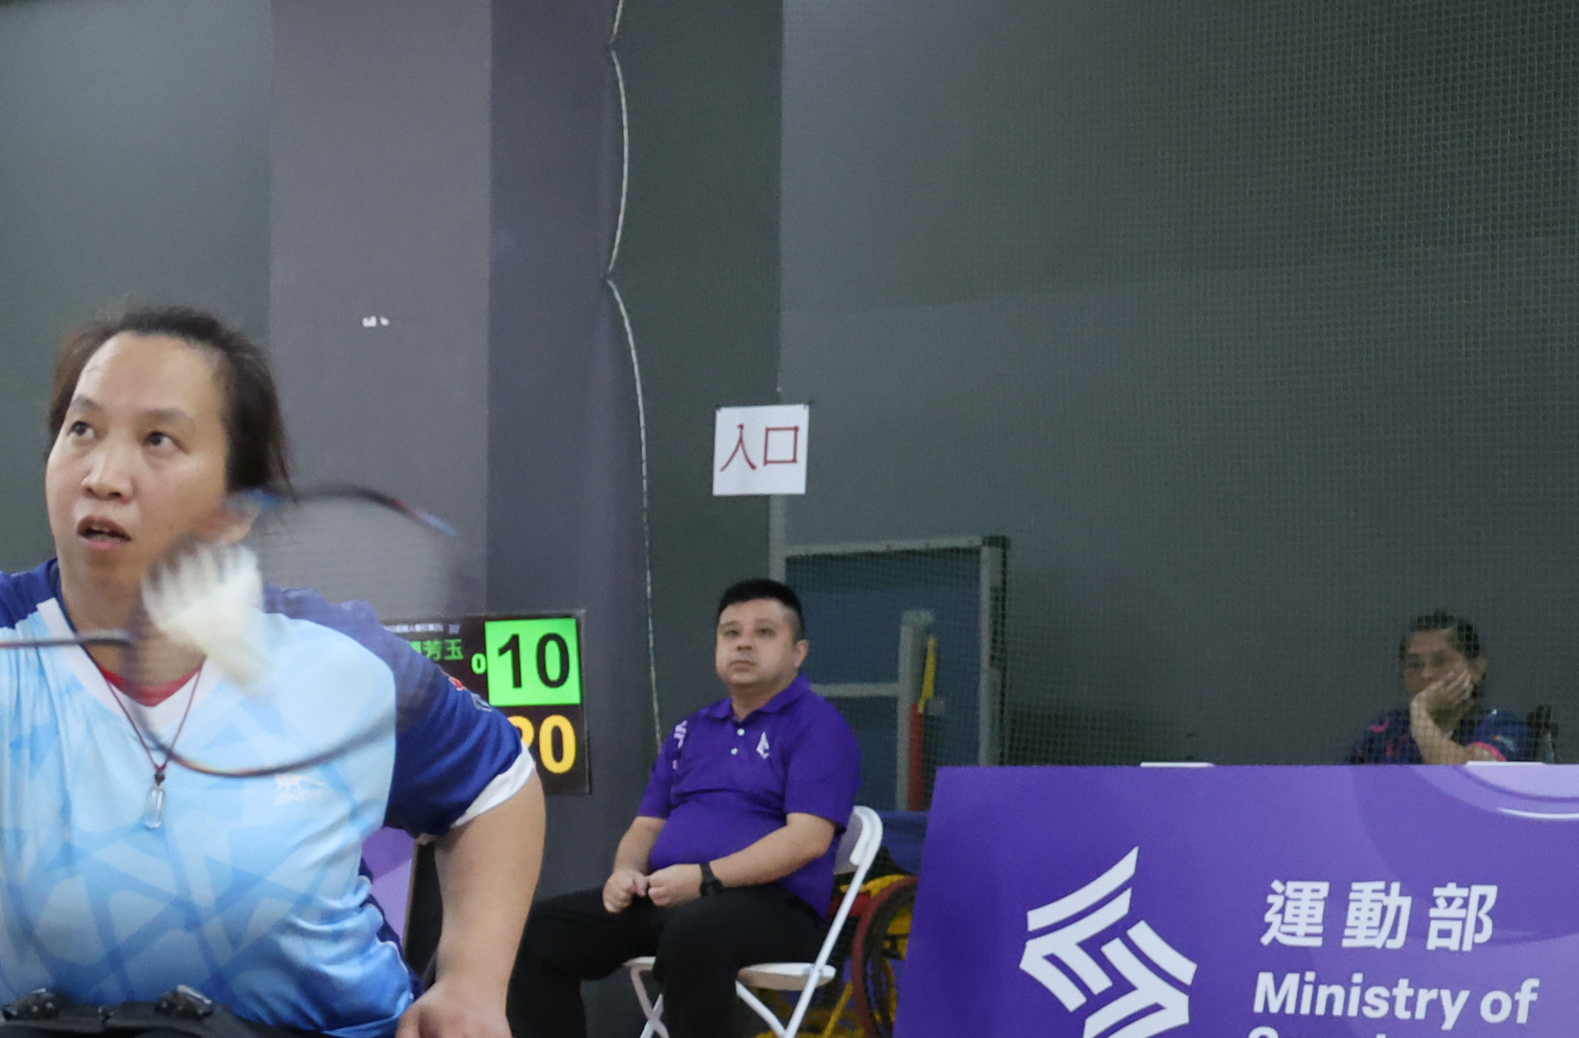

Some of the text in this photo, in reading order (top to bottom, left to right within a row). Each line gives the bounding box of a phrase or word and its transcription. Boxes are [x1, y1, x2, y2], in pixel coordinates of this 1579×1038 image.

[498, 633, 570, 688] 10
[1260, 880, 1498, 951] 運動部
[1253, 971, 1540, 1030] Ministry of
